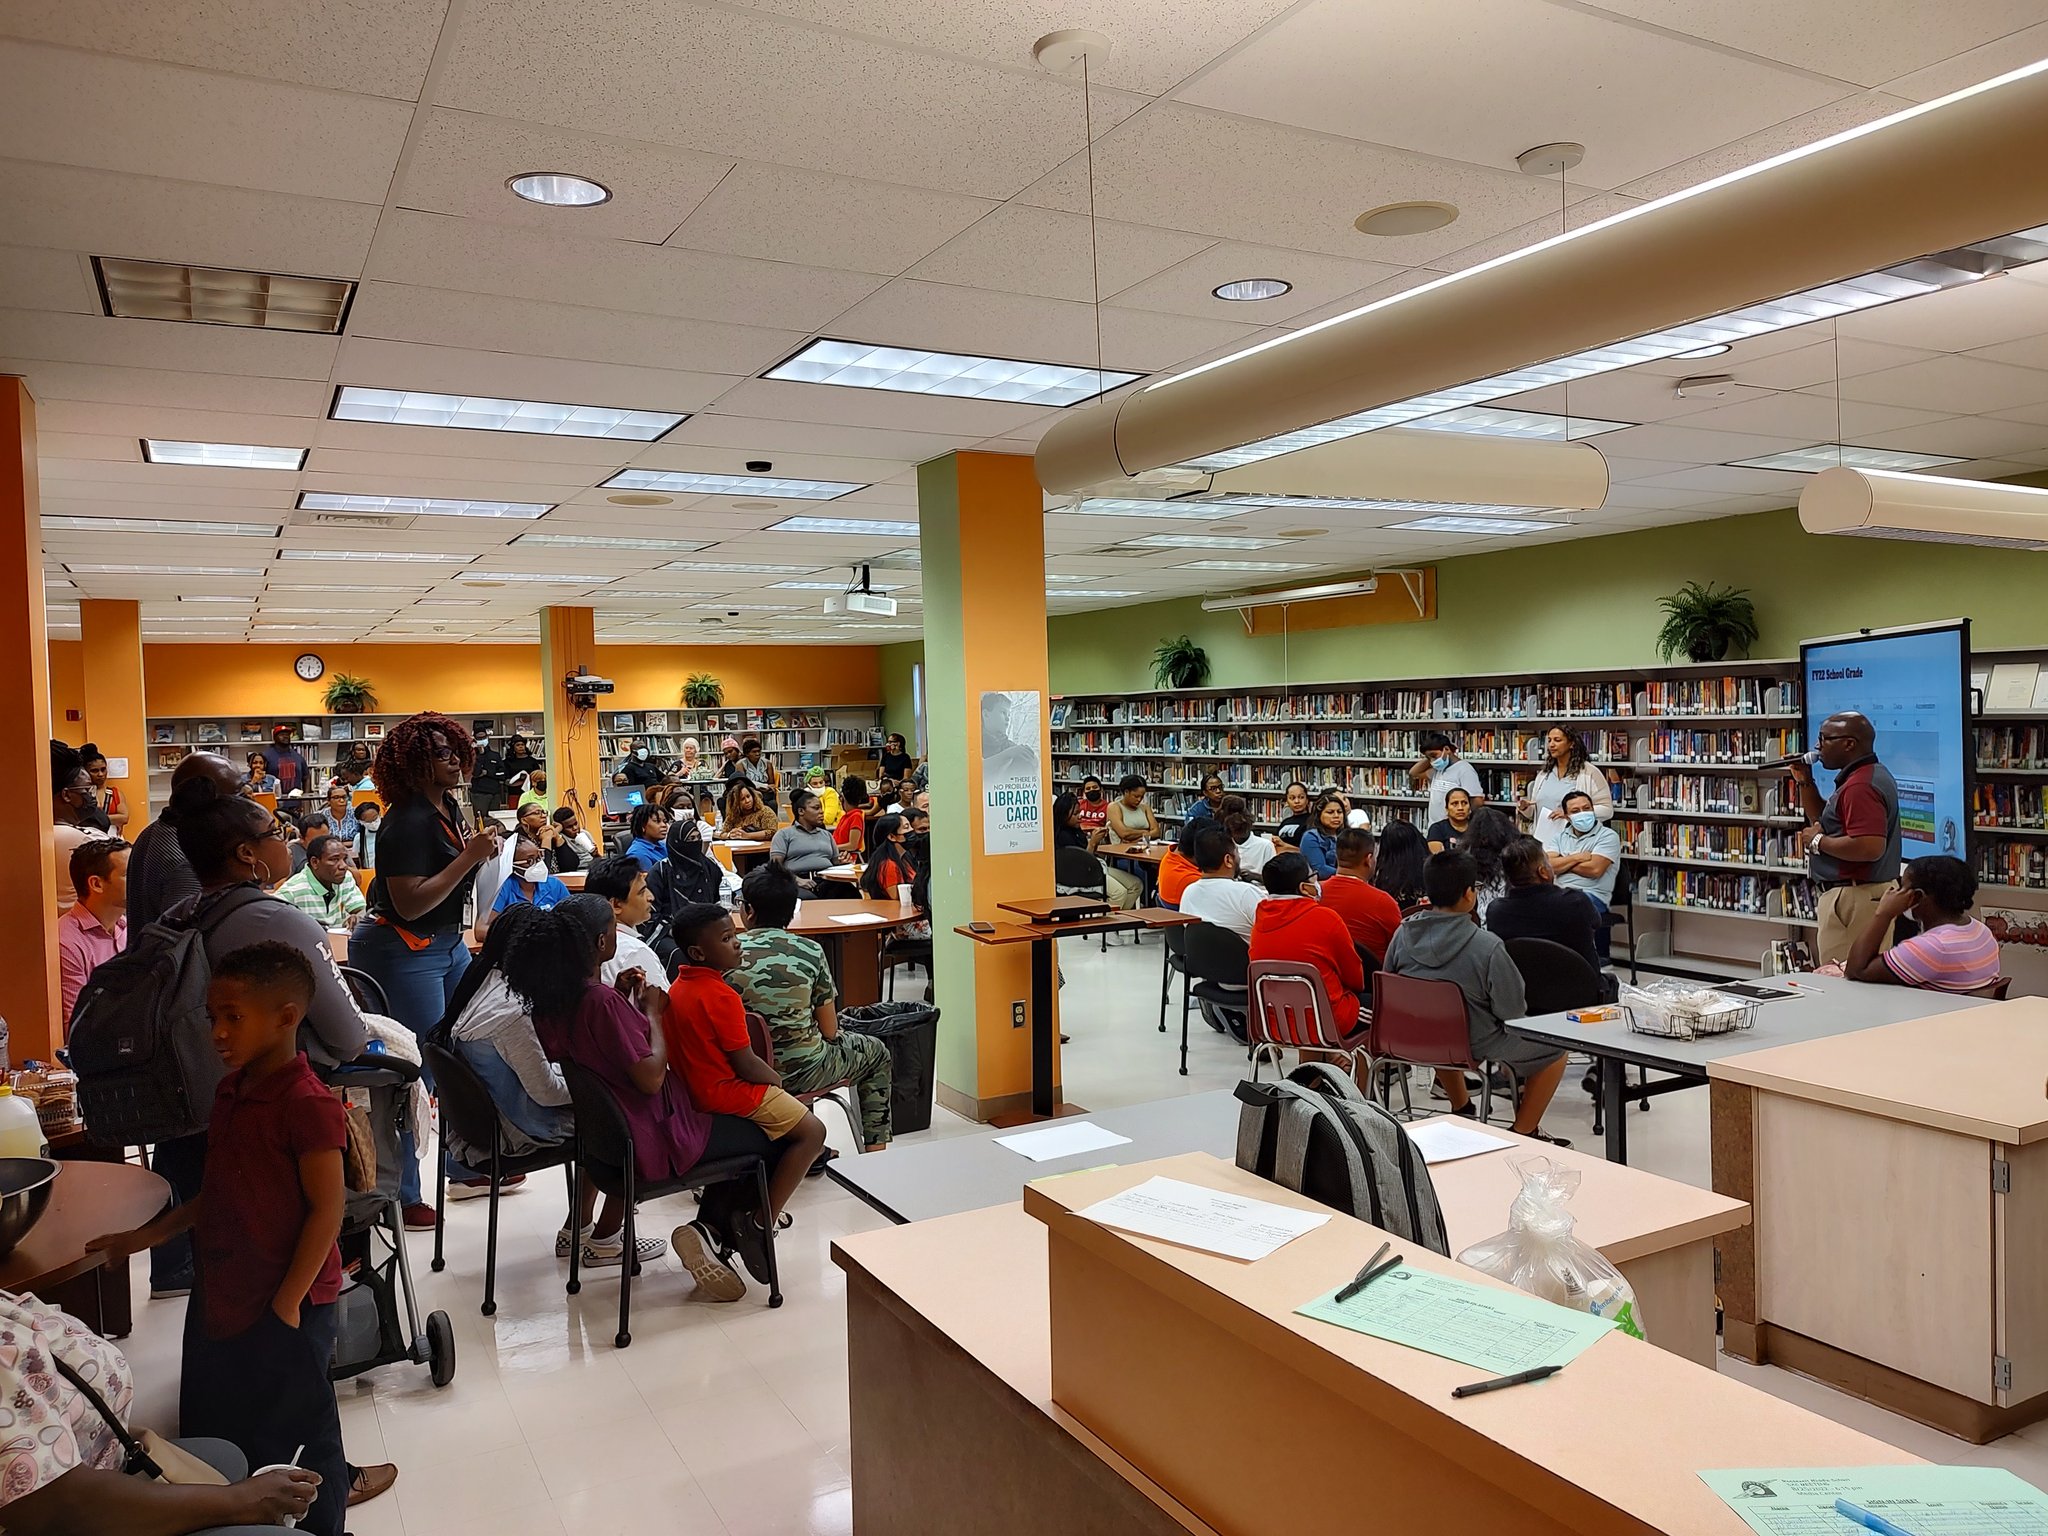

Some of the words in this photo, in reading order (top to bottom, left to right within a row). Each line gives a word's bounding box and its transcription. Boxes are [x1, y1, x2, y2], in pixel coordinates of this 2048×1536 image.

[1826, 668, 1845, 680] School
[1845, 667, 1864, 679] Grade
[988, 789, 1038, 807] LIBRARY
[1006, 806, 1038, 822] CARD
[1080, 809, 1106, 819] AERO
